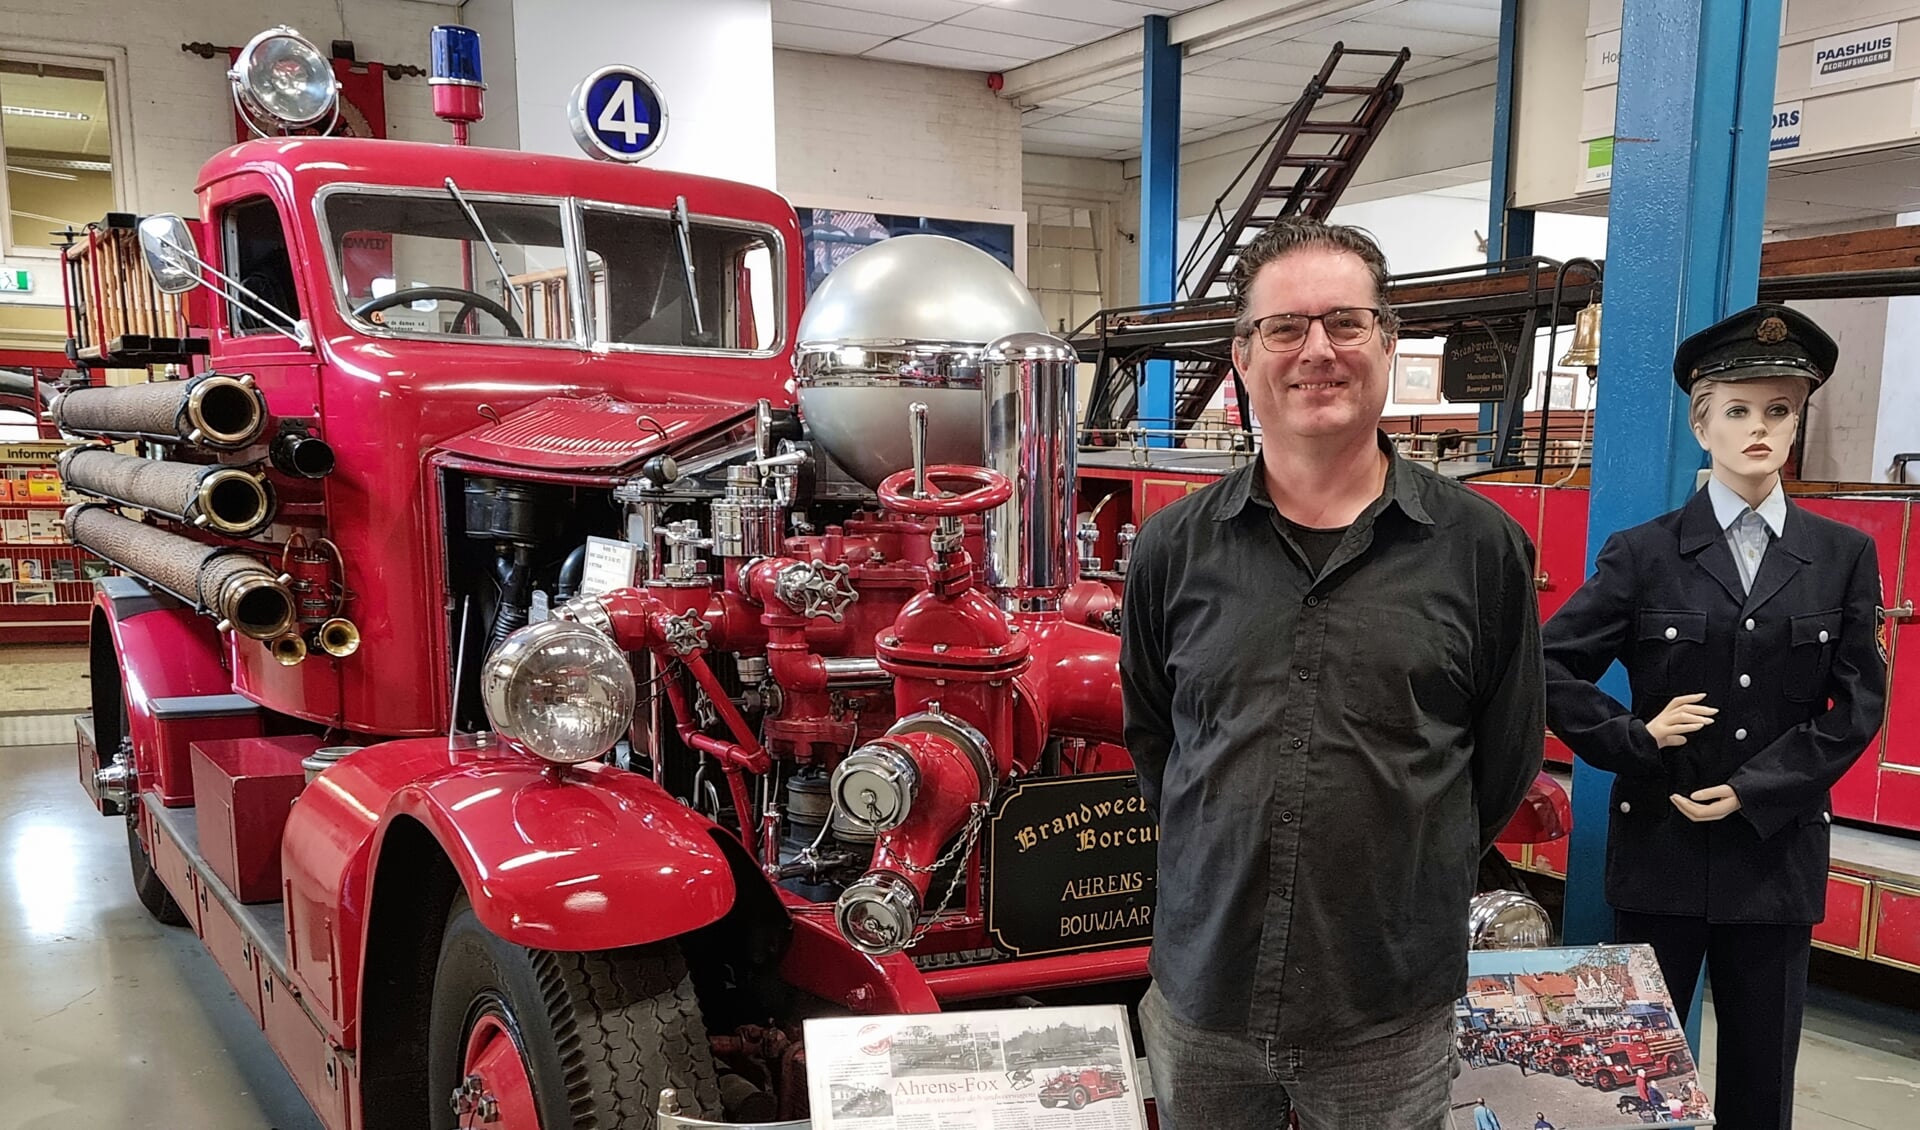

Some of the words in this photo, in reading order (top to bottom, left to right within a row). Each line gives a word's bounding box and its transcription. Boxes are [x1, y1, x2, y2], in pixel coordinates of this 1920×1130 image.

[1816, 37, 1892, 64] PAASHUIS
[1822, 52, 1889, 71] BEDRIJFSWAGENS
[597, 80, 650, 144] 4
[1060, 905, 1151, 937] BOUWJAAR
[895, 1076, 999, 1096] Ahrens-Fox
